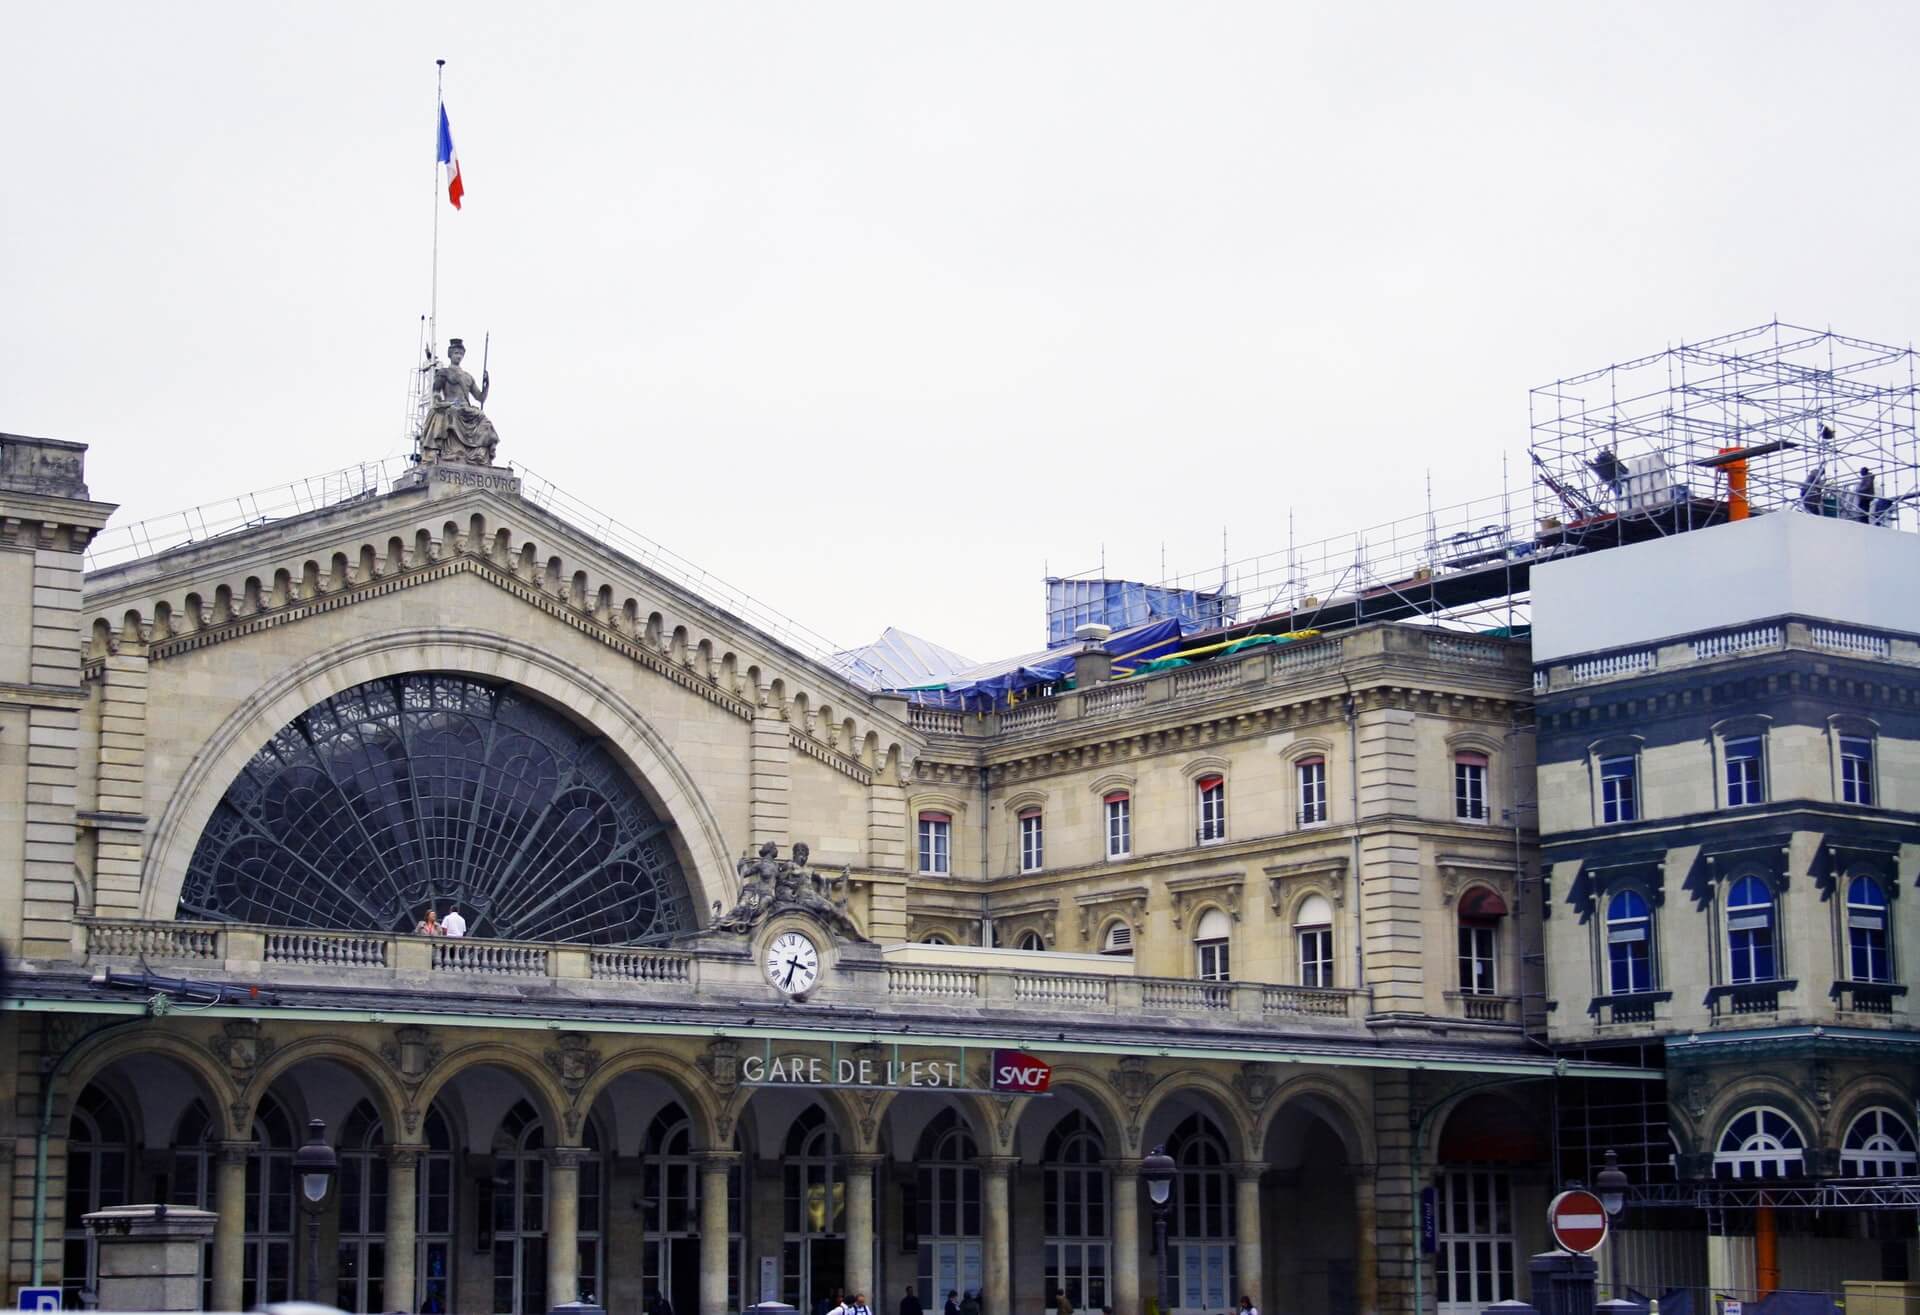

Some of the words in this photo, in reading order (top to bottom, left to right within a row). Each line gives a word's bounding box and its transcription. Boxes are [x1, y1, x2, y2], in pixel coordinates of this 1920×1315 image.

[743, 1056, 822, 1083] GARE
[838, 1059, 872, 1084] DE
[887, 1061, 958, 1087] L'EST
[996, 1066, 1049, 1086] SNCF
[37, 1295, 58, 1313] P
